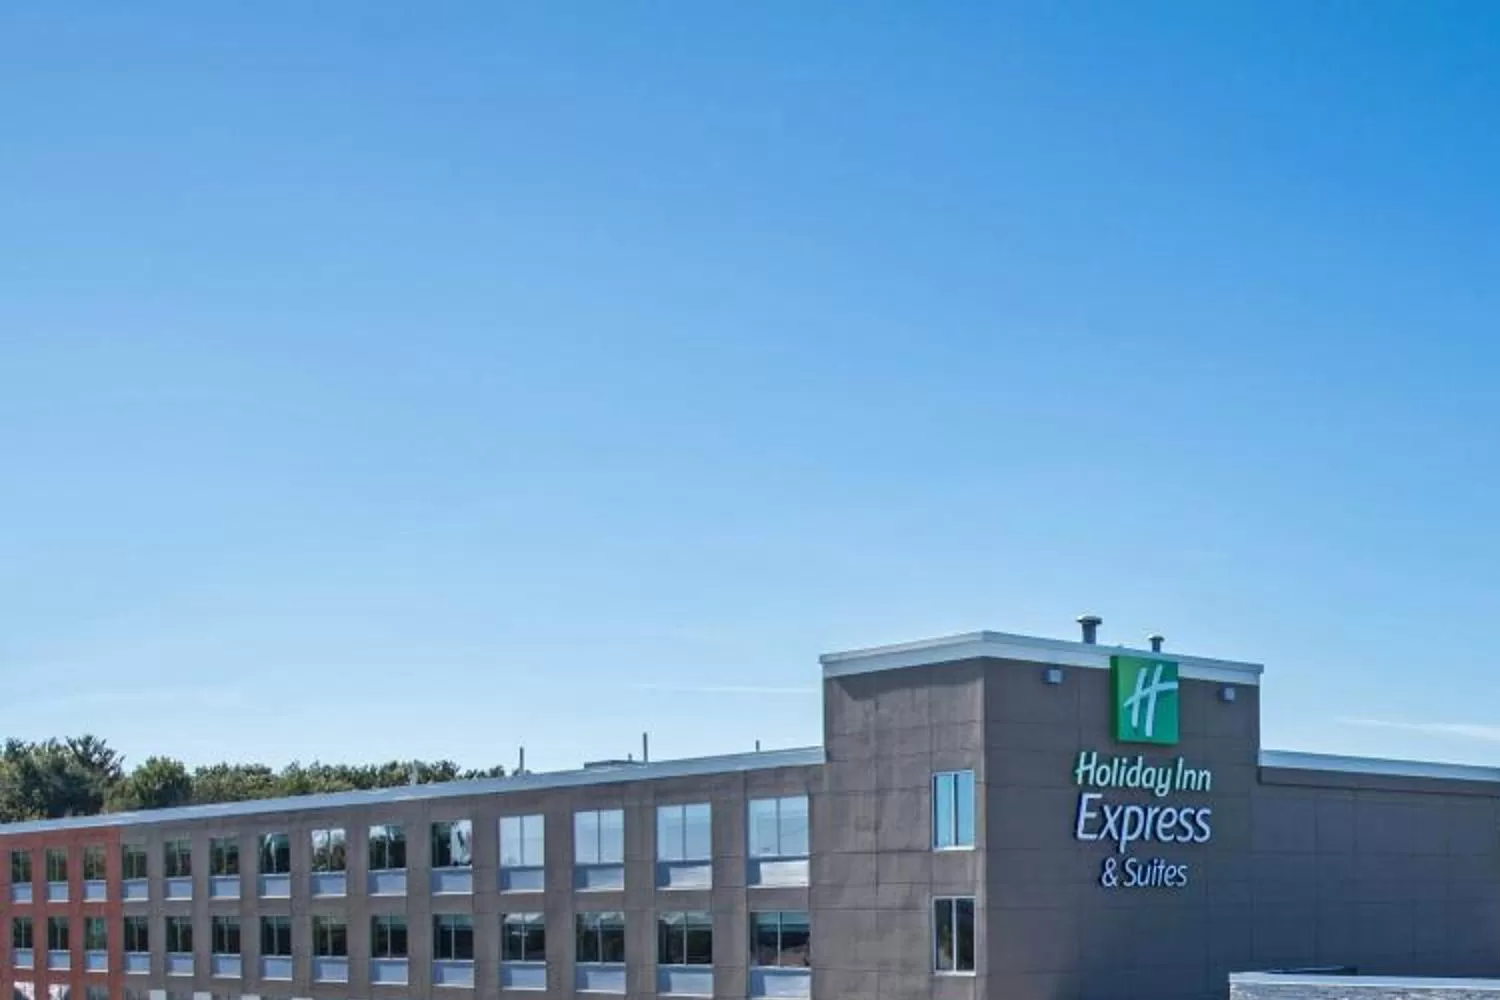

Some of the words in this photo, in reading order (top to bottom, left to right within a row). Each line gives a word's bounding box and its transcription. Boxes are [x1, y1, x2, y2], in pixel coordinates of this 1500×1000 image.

[1124, 664, 1178, 737] H
[1075, 751, 1171, 797] Holiday
[1175, 756, 1212, 792] Inn
[1076, 793, 1212, 854] Express
[1102, 857, 1118, 888] &
[1124, 857, 1188, 887] Suites
